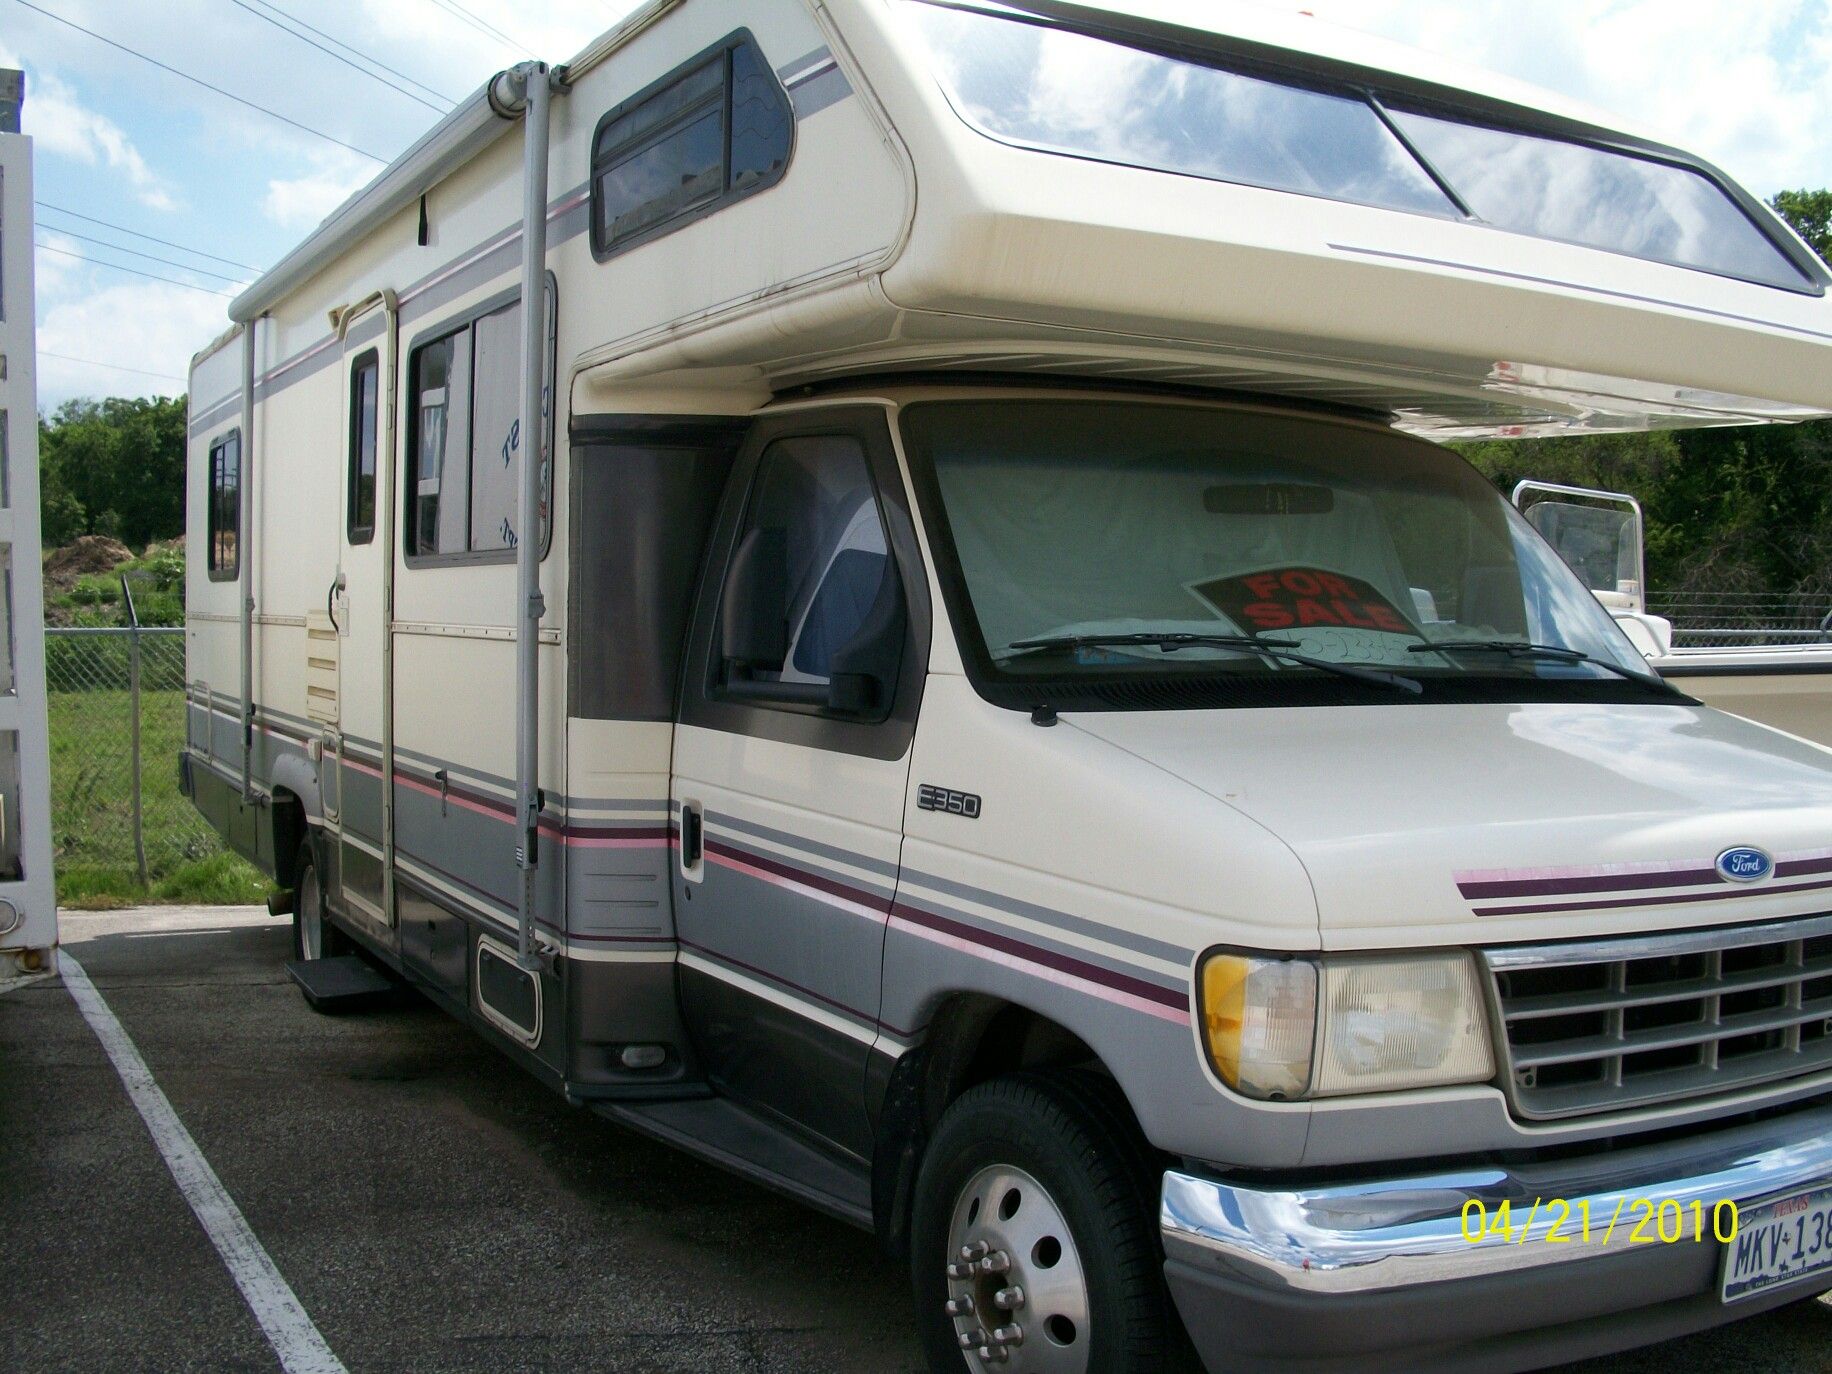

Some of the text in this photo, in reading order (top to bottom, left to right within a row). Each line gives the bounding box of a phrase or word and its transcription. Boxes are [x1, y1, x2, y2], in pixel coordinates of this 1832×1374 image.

[1244, 570, 1360, 600] FOR
[1243, 600, 1409, 632] SALE
[917, 785, 979, 817] E350
[1731, 854, 1760, 873] Ford
[1773, 1194, 1809, 1219] TEXAS
